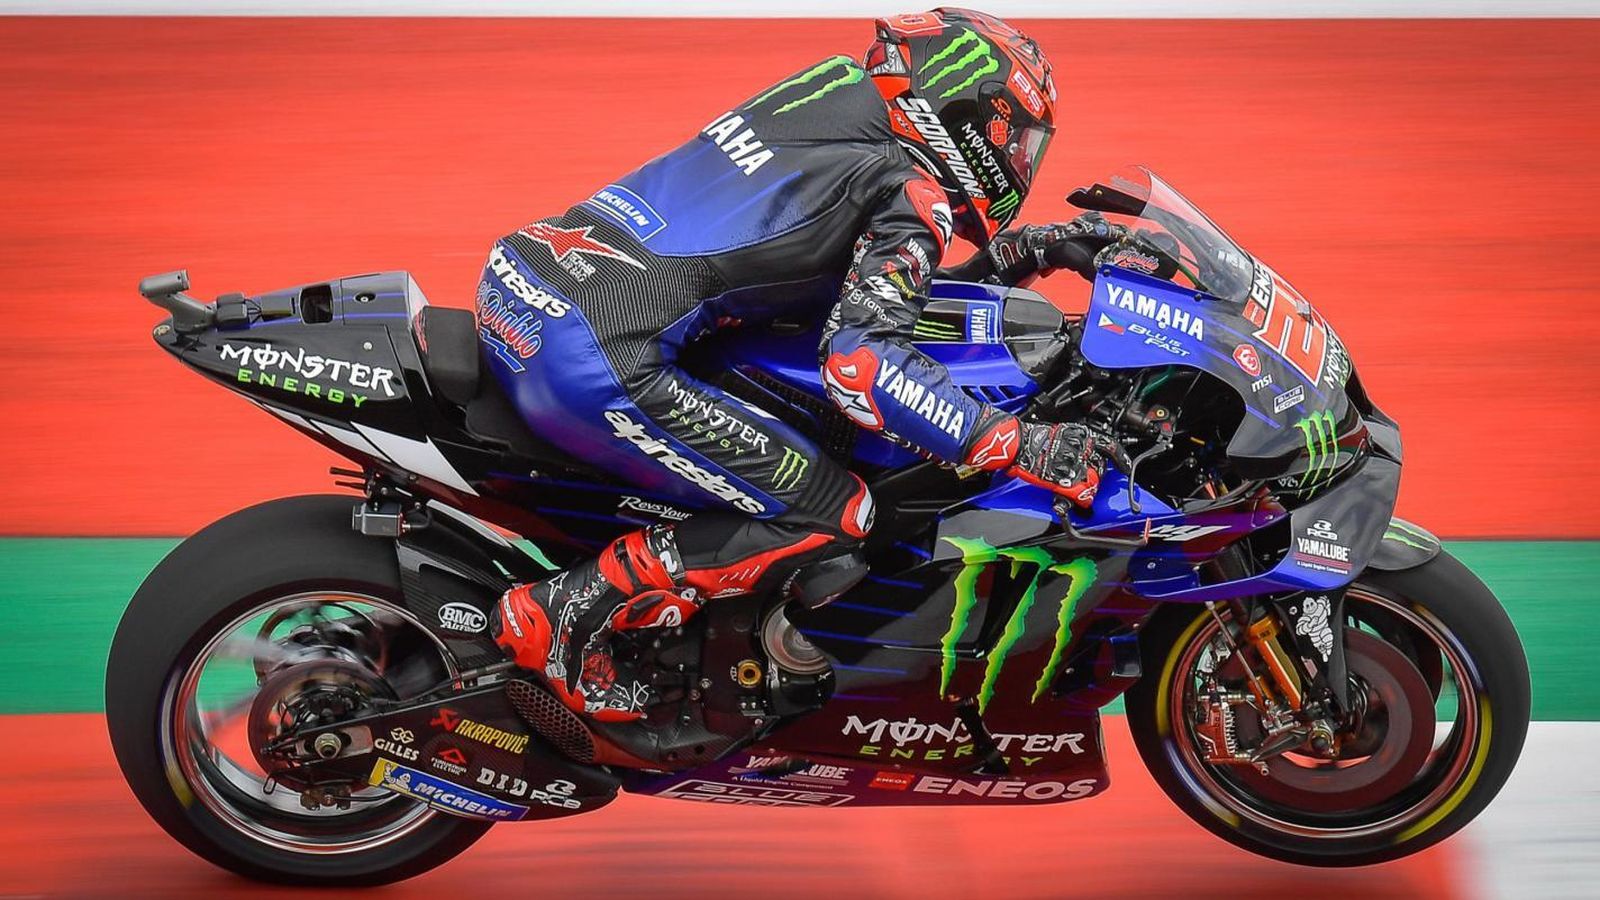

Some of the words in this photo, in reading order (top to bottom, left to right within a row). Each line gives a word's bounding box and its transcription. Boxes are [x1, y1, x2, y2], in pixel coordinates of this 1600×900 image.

[896, 97, 985, 194] SCORPION
[959, 142, 993, 190] ENERGY
[961, 122, 1010, 193] MONSTER
[596, 190, 650, 227] MICHELIN
[863, 297, 899, 328] fantom
[1106, 282, 1204, 342] YAMAHA
[220, 343, 395, 397] MONSTER
[237, 368, 367, 408] ENERGY
[668, 380, 770, 455] MONSTER
[875, 360, 965, 439] YAMAHA
[669, 408, 745, 456] ENERGY
[604, 411, 766, 514] alpinestars
[1297, 537, 1350, 562] YAMALUBE
[443, 607, 483, 629] BMC
[374, 738, 420, 762] GILLES
[859, 743, 1044, 767] ENERY
[413, 782, 513, 818] MICHELIN
[913, 775, 1097, 801] ENEOS
